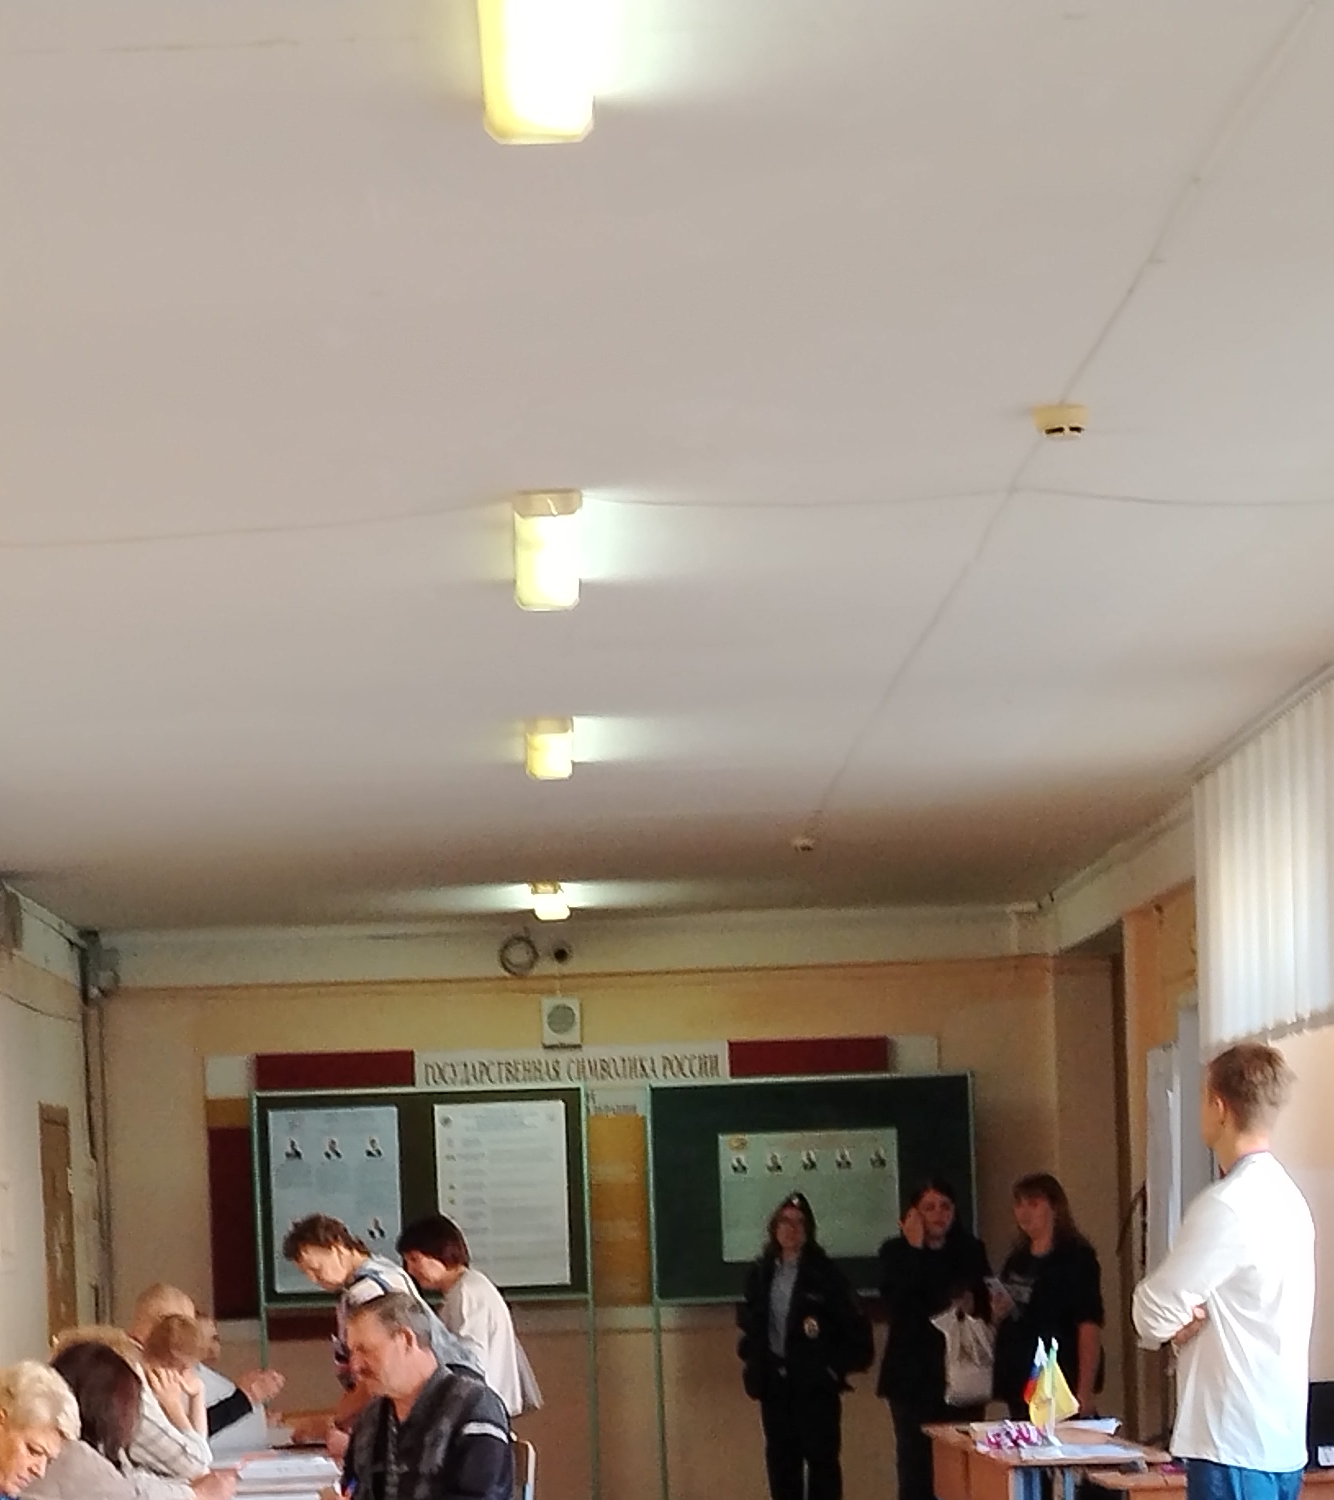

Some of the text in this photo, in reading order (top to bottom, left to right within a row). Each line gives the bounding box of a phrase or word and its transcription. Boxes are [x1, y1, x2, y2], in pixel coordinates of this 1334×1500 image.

[423, 1053, 721, 1086] ГОСУДАРСТВЕННАЯ СИМВОЛИКА РОССИИ
